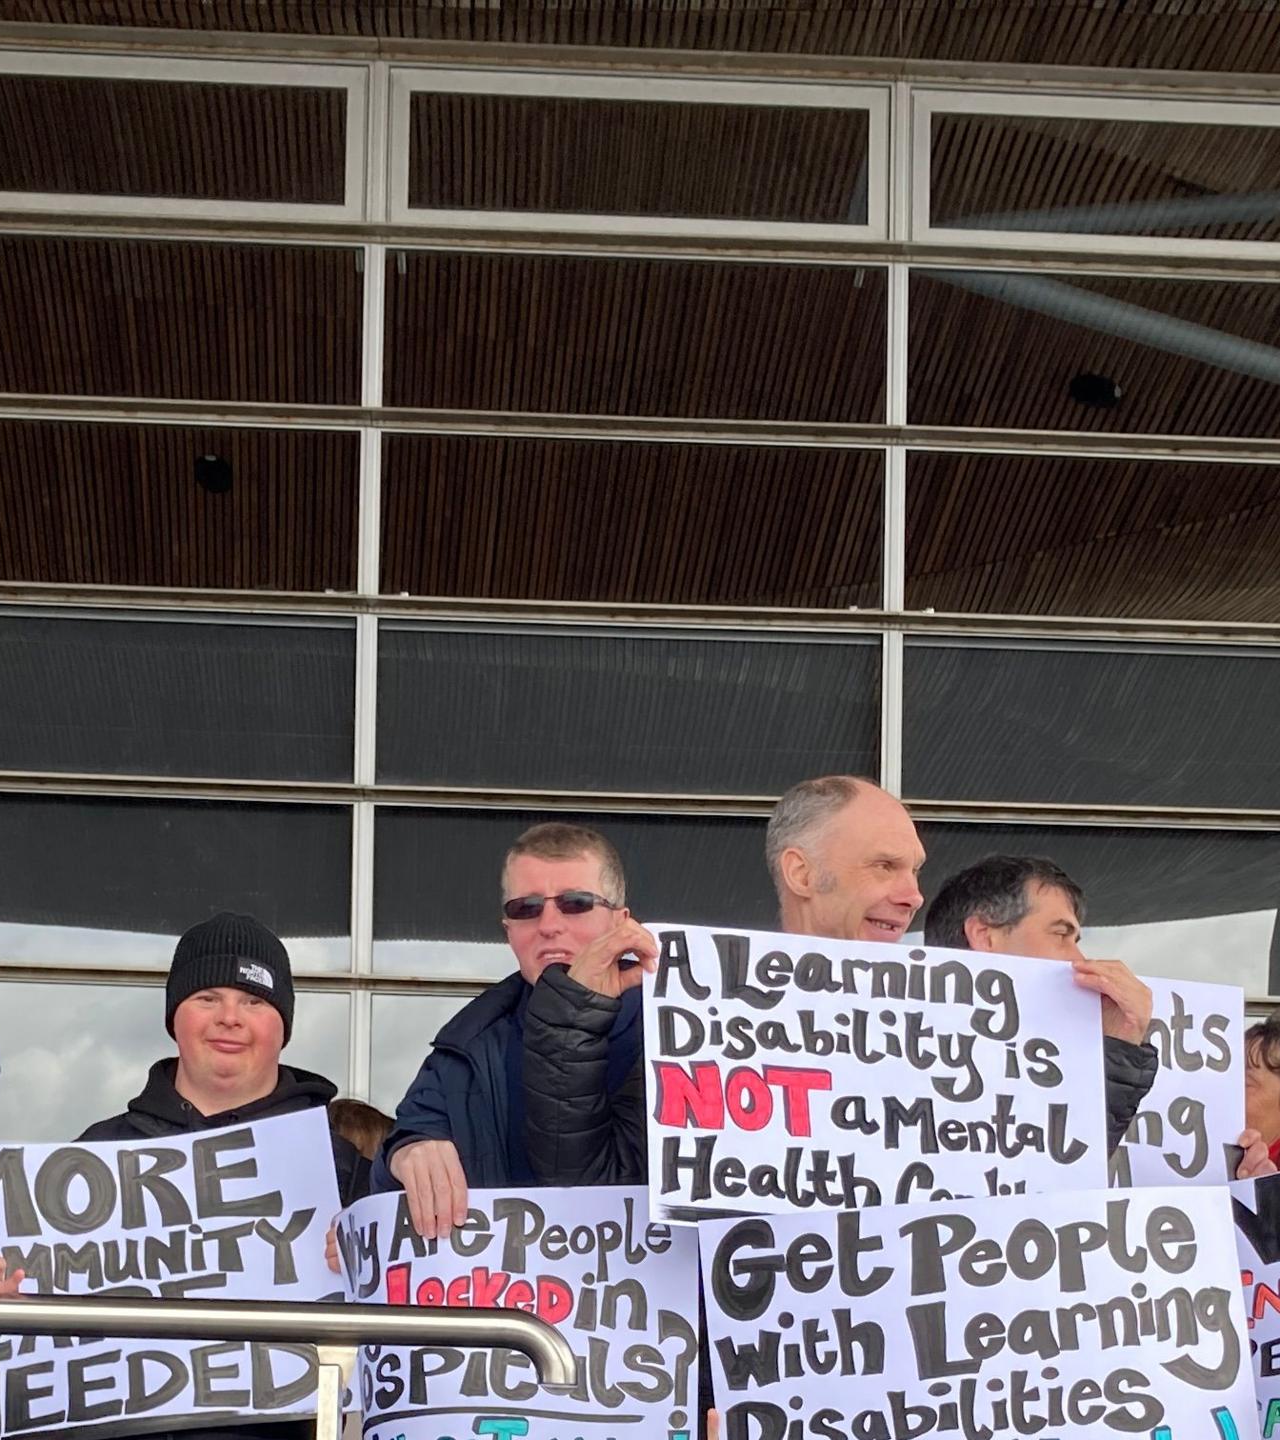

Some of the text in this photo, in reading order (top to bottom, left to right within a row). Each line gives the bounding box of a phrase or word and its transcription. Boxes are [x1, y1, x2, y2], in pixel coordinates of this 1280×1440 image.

[652, 930, 1021, 1041] A Learning
[658, 1004, 1064, 1102] Disability is
[651, 1060, 1089, 1165] NOT a Mental
[660, 1135, 882, 1209] Health
[492, 1197, 672, 1283] People
[711, 1210, 895, 1322] Get
[573, 1272, 648, 1332] in
[905, 1282, 1241, 1391] Learning
